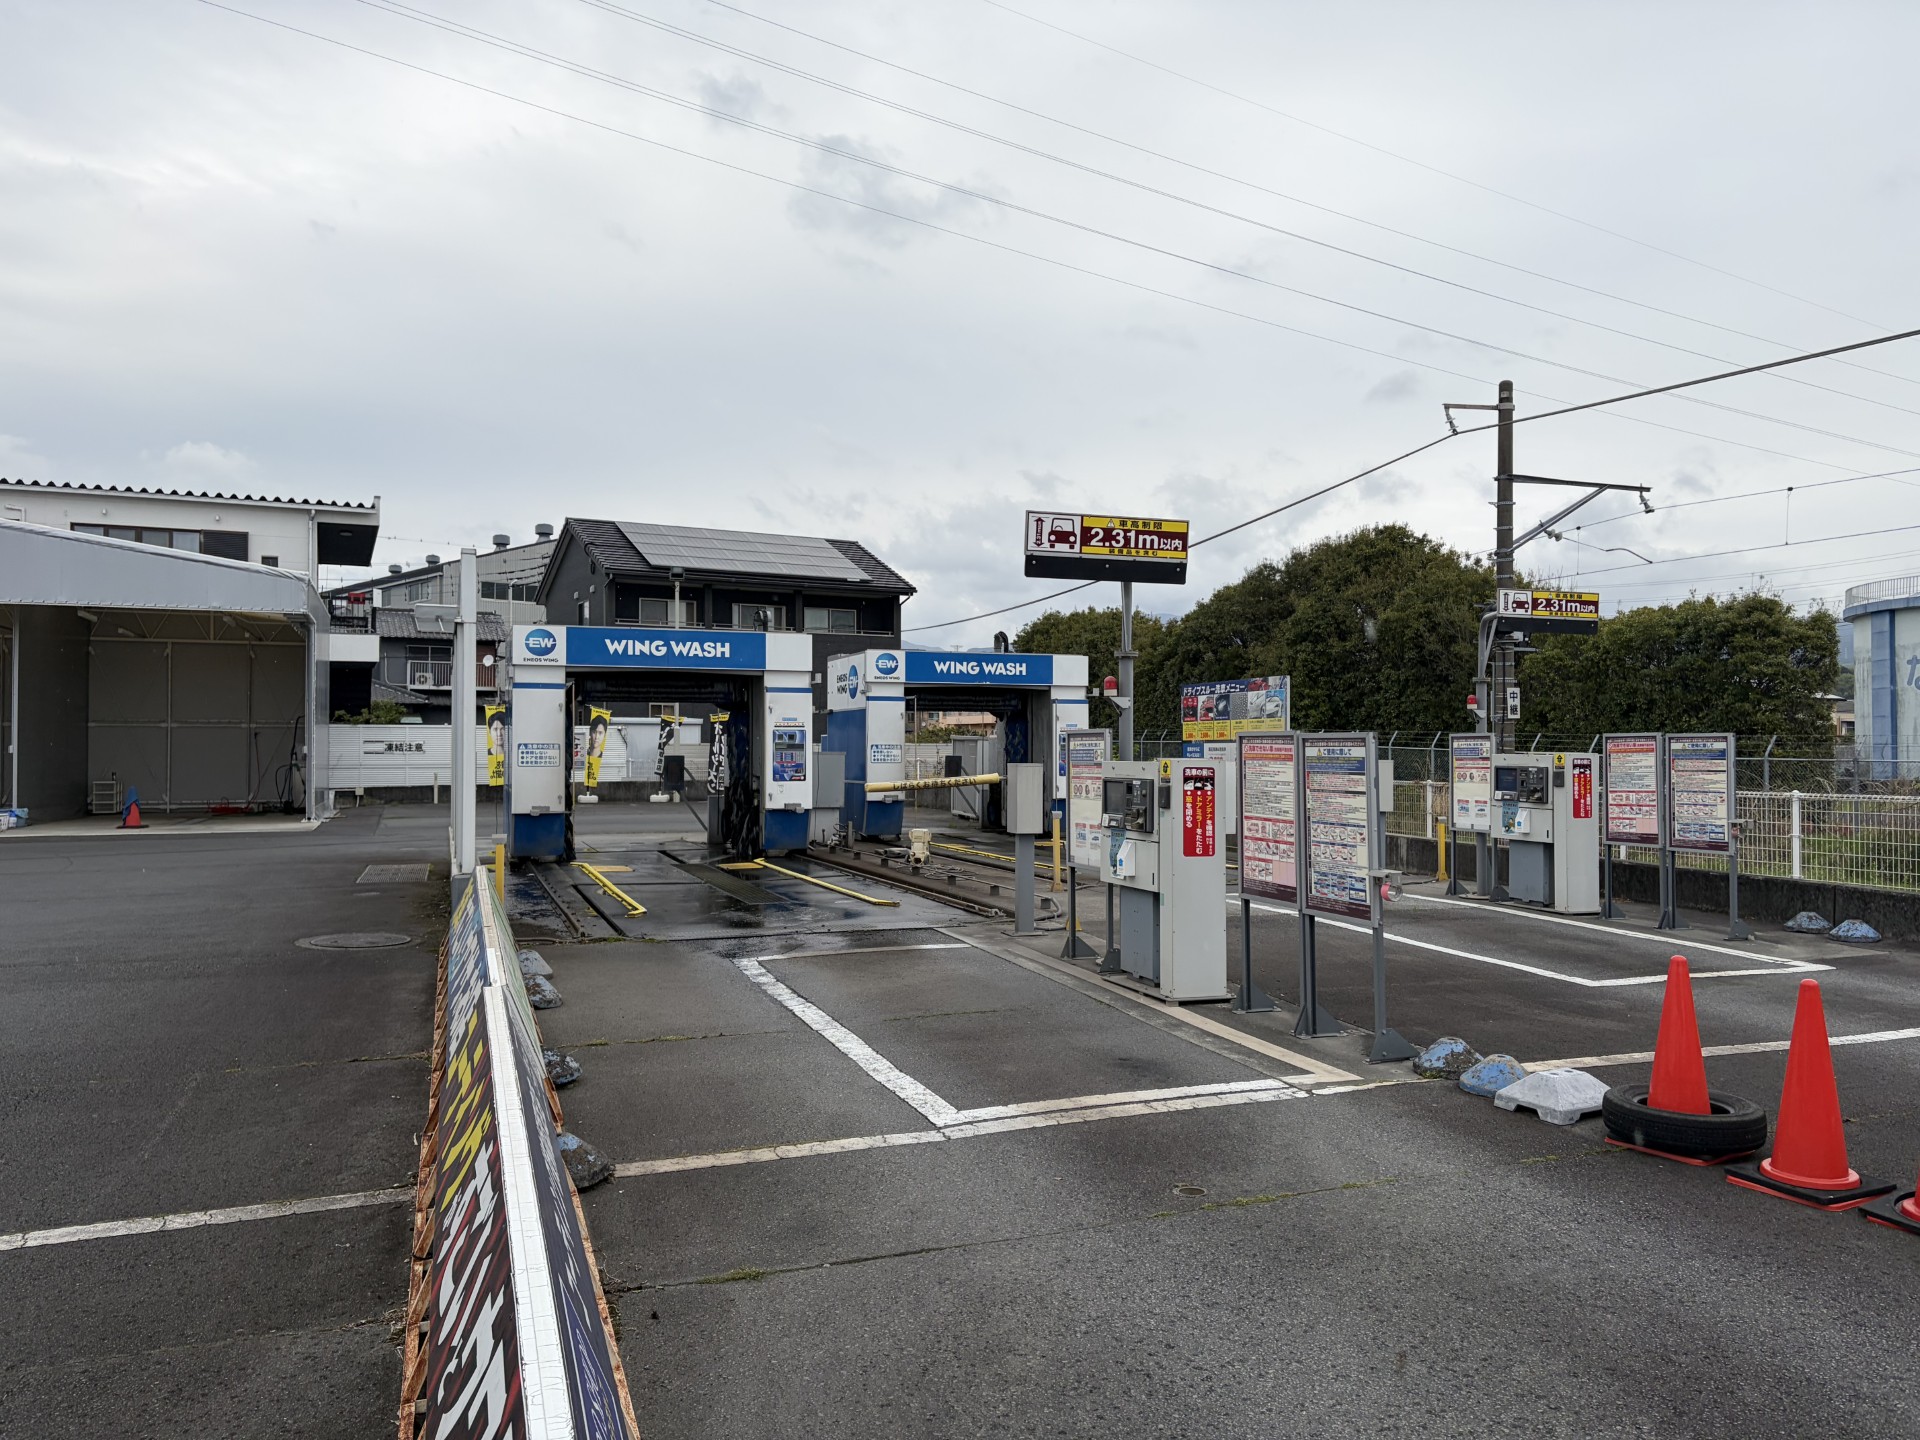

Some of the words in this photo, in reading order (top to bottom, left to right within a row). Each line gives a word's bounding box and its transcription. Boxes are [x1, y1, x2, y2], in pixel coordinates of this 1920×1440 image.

[1119, 519, 1163, 530] 車高制限
[1089, 527, 1183, 551] 2.31m以内
[529, 637, 553, 648] EW
[604, 638, 667, 657] WING
[669, 640, 730, 658] WASH
[878, 660, 897, 669] EW
[933, 661, 980, 675] WING
[981, 662, 1027, 676] WASH
[836, 684, 848, 695] WING
[384, 742, 424, 752] 凍結注意
[1184, 768, 1214, 776] 洗車の前に
[893, 776, 977, 791] しばらくお待ちください
[1195, 796, 1203, 855] ドアミラーをたたむ
